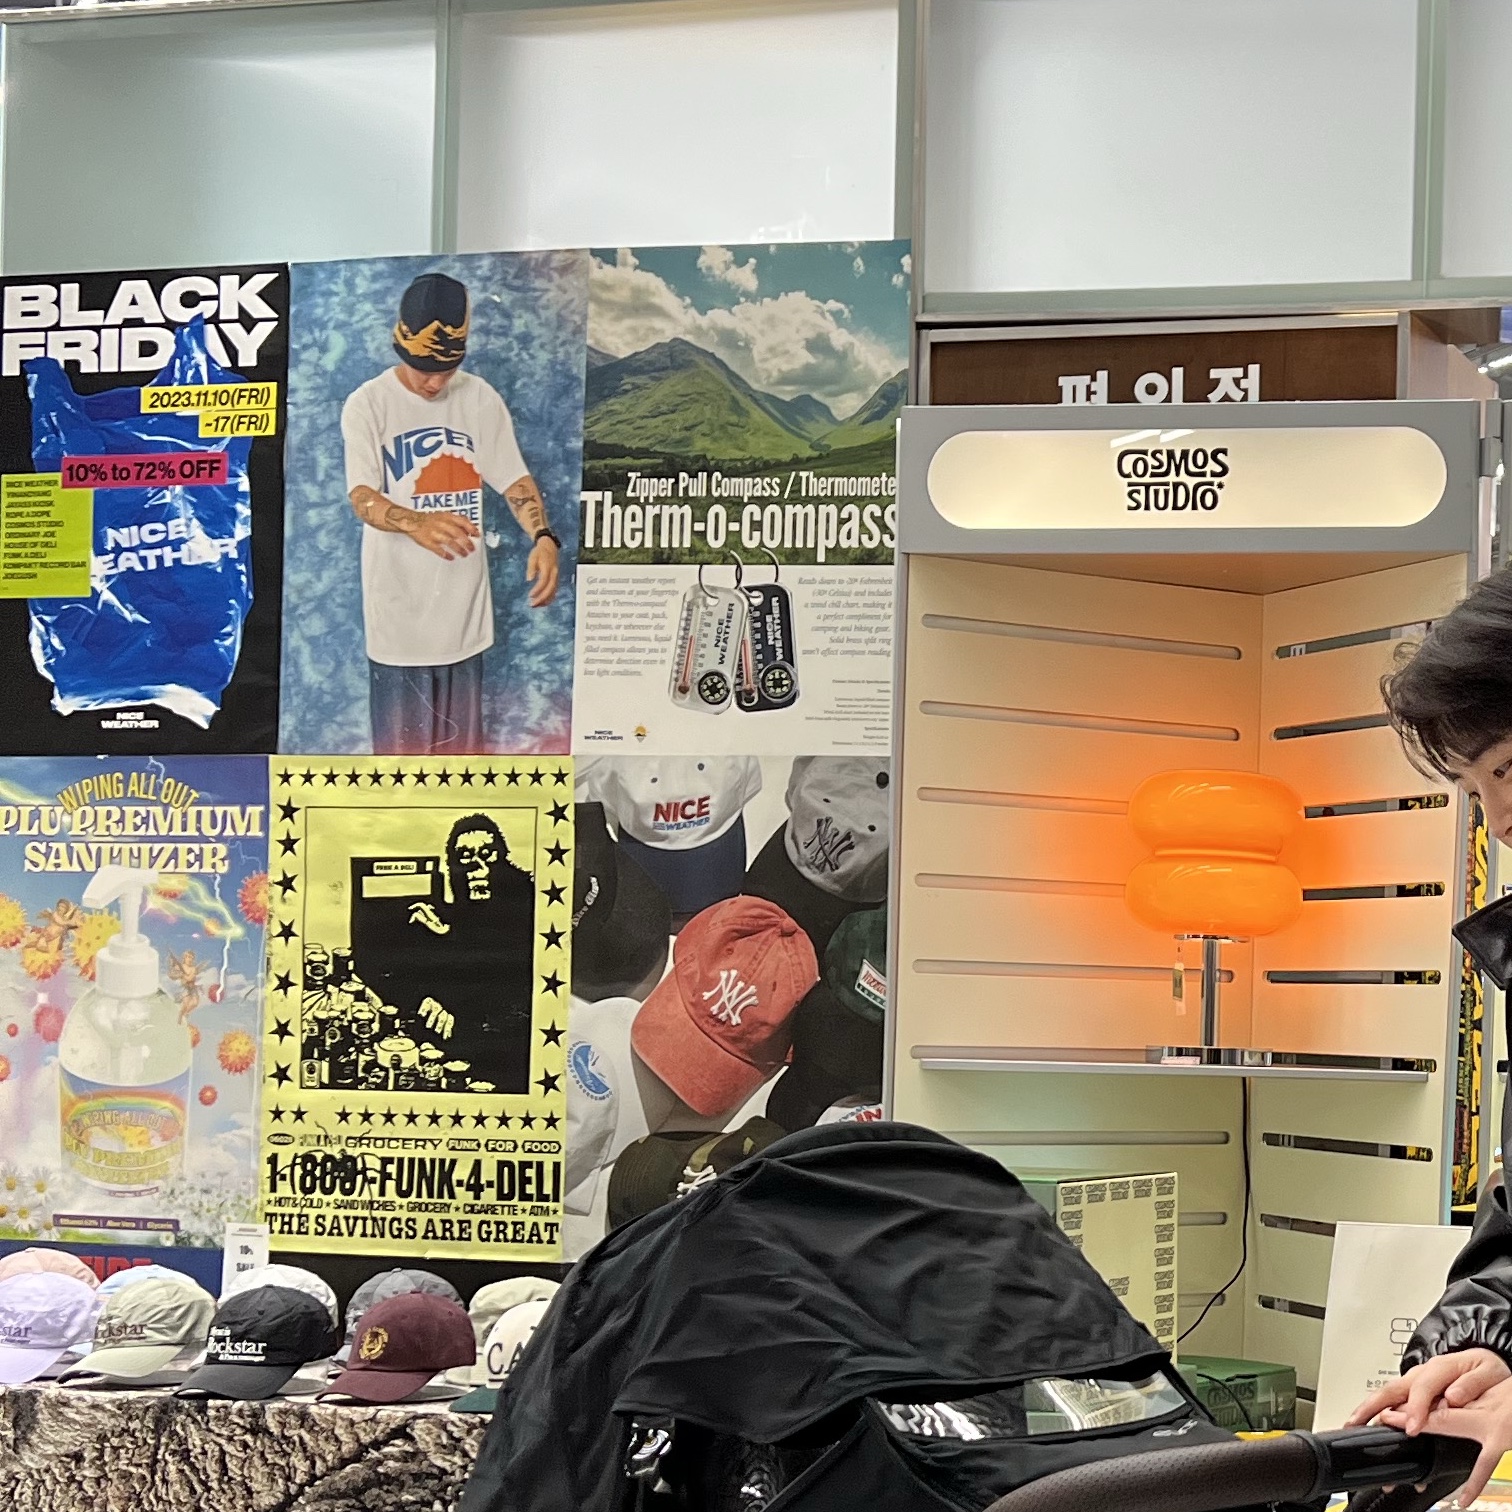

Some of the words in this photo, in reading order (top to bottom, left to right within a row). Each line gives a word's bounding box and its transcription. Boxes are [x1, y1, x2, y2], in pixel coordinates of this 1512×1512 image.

[3, 273, 280, 329] BLACK
[149, 388, 270, 408] 2023.11.10(FRI)
[66, 463, 107, 482] 10%
[112, 463, 131, 480] to
[134, 461, 175, 480] 72%
[179, 459, 221, 479] OFF
[411, 493, 453, 509] TAKE
[456, 491, 478, 506] ME
[627, 472, 676, 503] Zipper
[678, 471, 707, 497] Pull
[711, 472, 780, 502] Compass
[106, 518, 187, 550] NICE
[580, 491, 896, 563] Therm-o-compass
[714, 618, 724, 648] NICE
[718, 602, 735, 665] WEATHER
[765, 614, 775, 645] NICE
[101, 720, 160, 728] WEATHER
[56, 772, 124, 814] WIPING
[127, 771, 157, 800] ALL
[160, 778, 200, 813] OUT
[0, 805, 63, 836] PLU
[69, 805, 266, 837] PREMIUM
[653, 796, 711, 822] NICE
[665, 817, 711, 831] WEATHER
[24, 841, 231, 875] SANITIZER
[345, 1136, 443, 1149] GROCERY
[449, 1140, 479, 1150] FUNK
[487, 1140, 515, 1151] FOR
[524, 1142, 559, 1152] FOOD
[333, 1199, 396, 1211] SANDWICHES
[264, 1212, 309, 1235] THE
[314, 1214, 417, 1240] SAVINGS
[421, 1218, 472, 1242] ARE
[478, 1220, 559, 1245] GREAT
